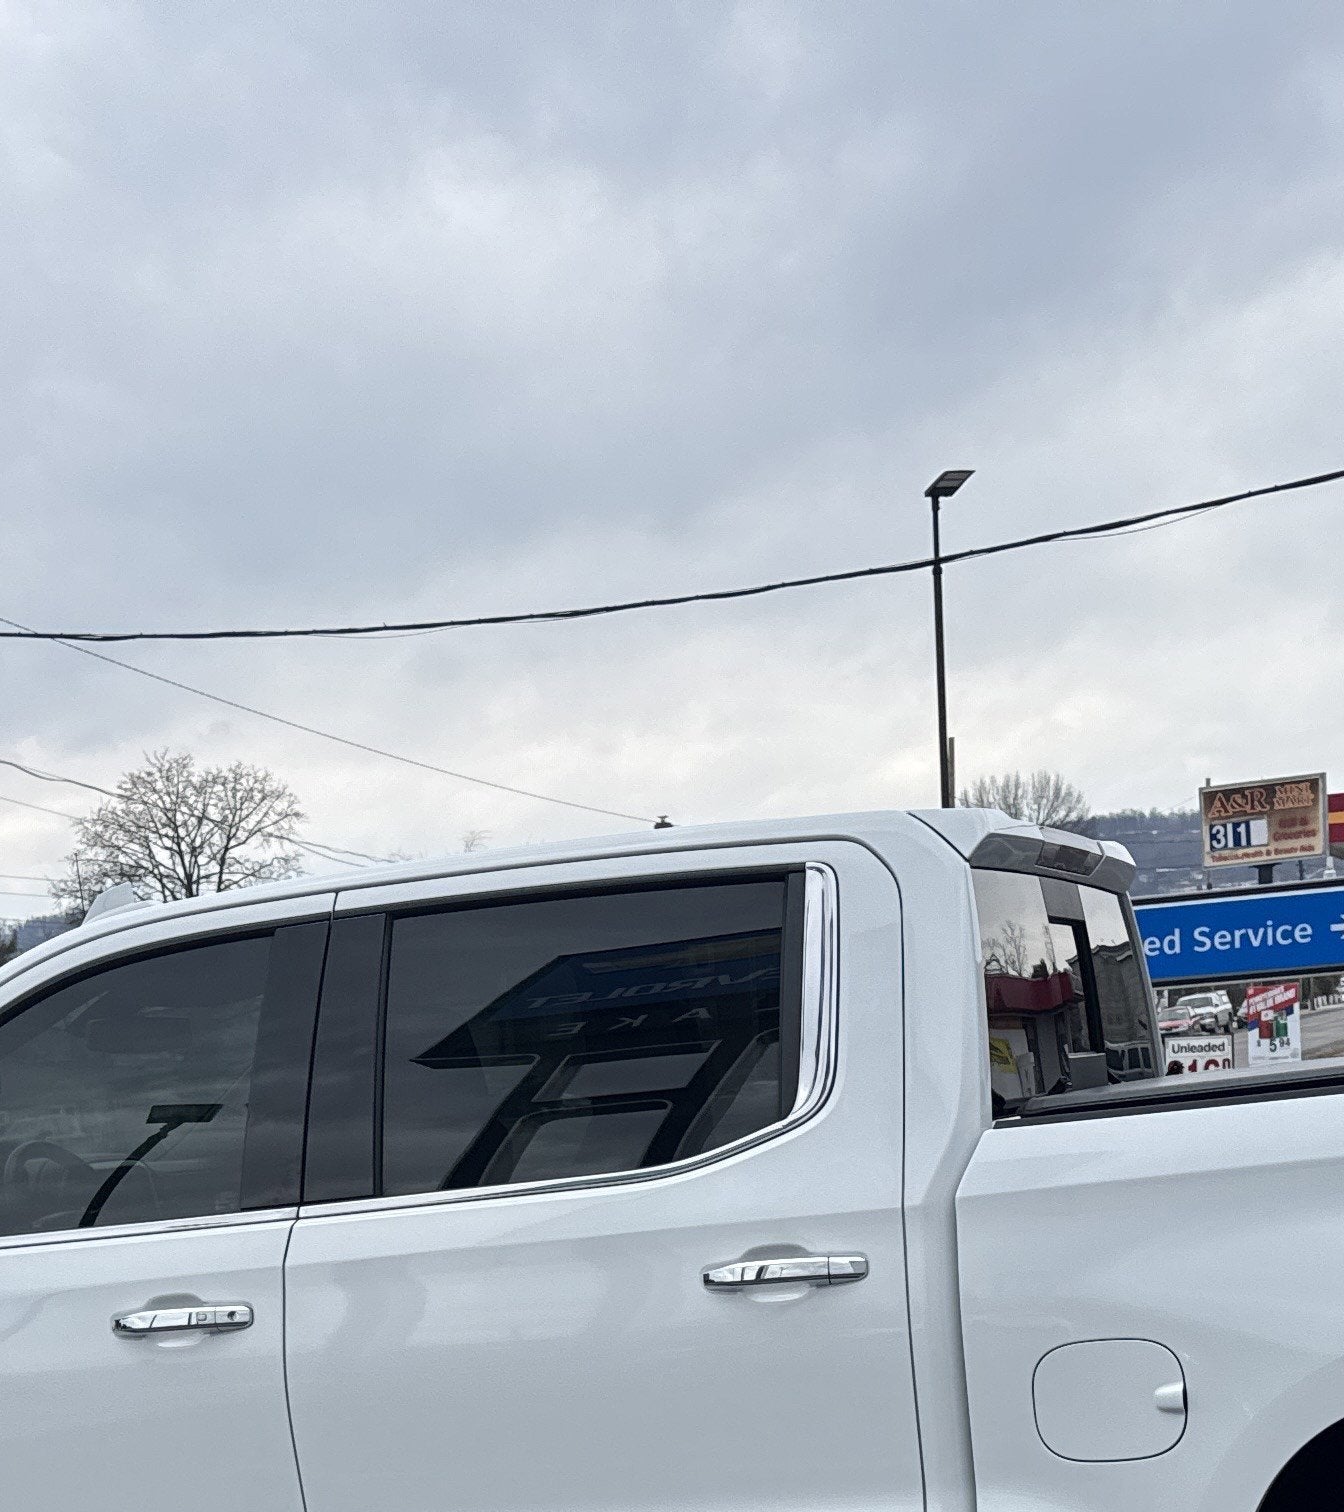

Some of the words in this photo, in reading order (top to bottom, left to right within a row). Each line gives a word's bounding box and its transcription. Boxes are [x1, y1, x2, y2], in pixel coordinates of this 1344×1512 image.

[1208, 788, 1270, 818] A&R
[1193, 920, 1313, 952] Service
[1171, 1041, 1226, 1054] Unleaded
